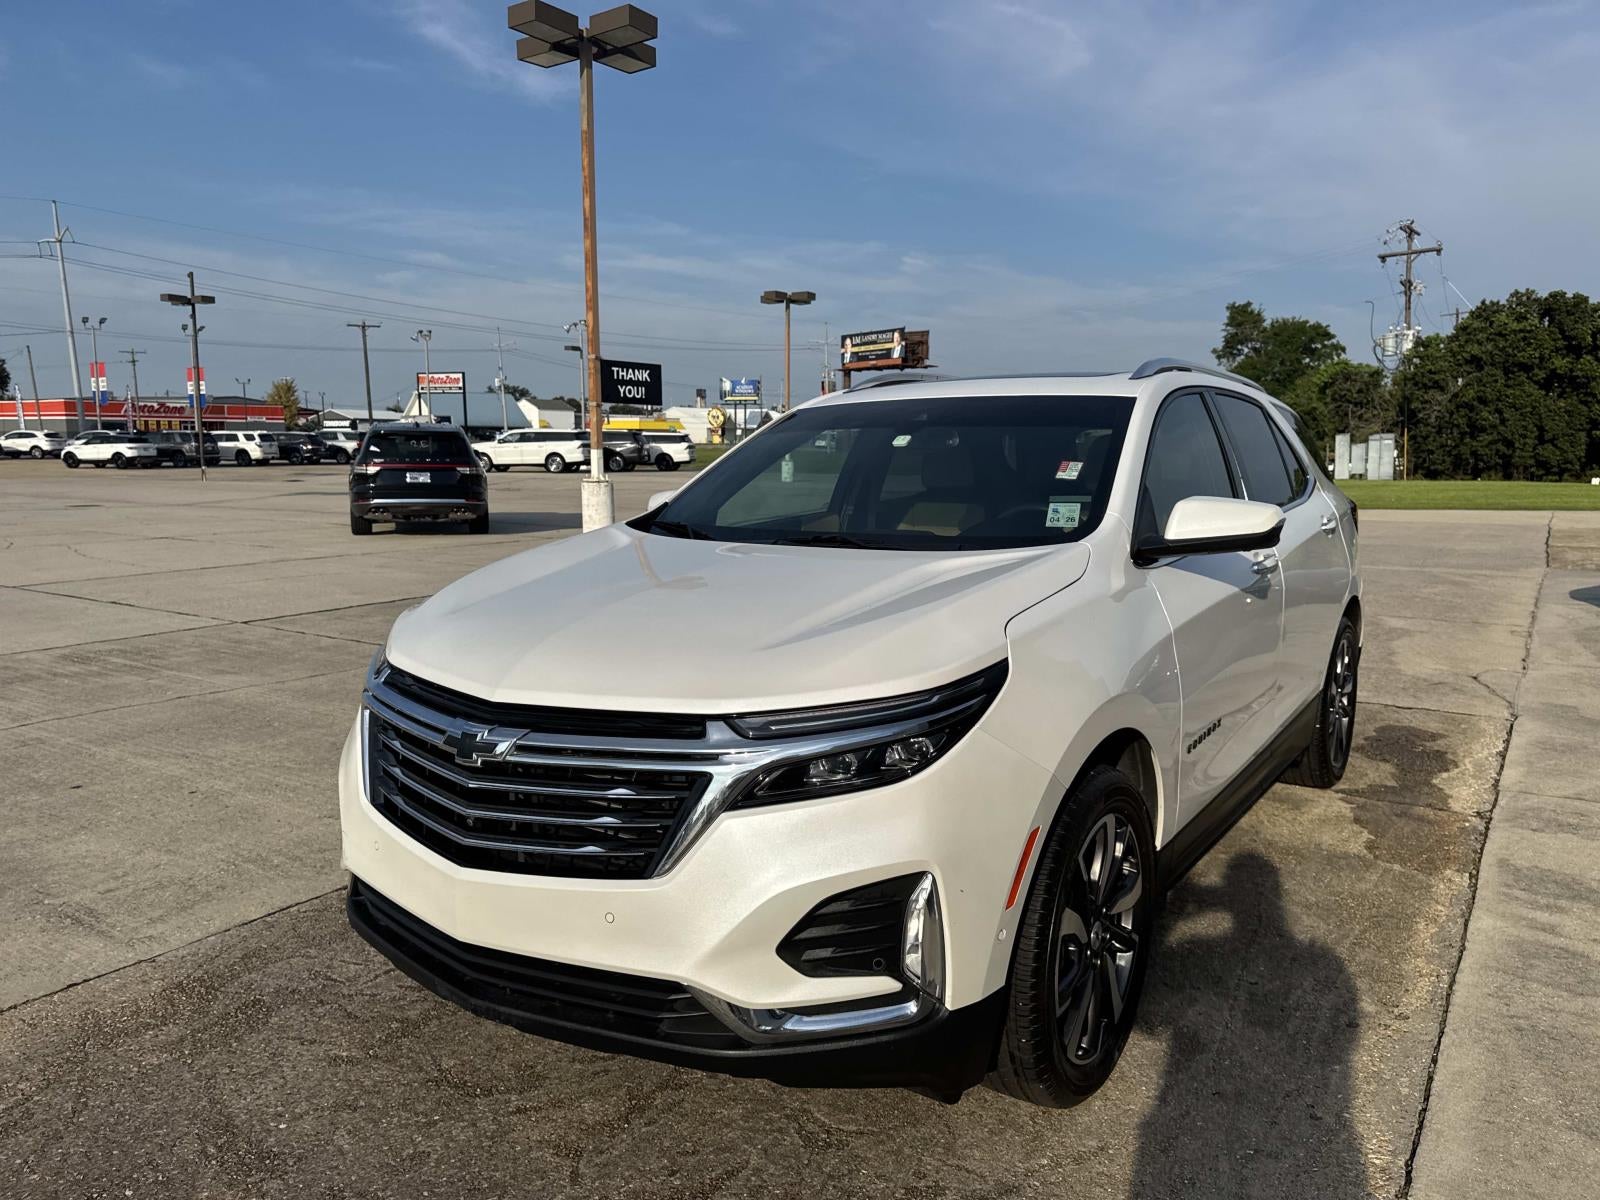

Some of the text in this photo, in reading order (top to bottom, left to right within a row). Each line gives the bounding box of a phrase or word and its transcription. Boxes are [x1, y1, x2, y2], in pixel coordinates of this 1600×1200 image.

[429, 375, 461, 385] AutoZone
[611, 366, 651, 382] THANK
[617, 384, 646, 399] YOU!
